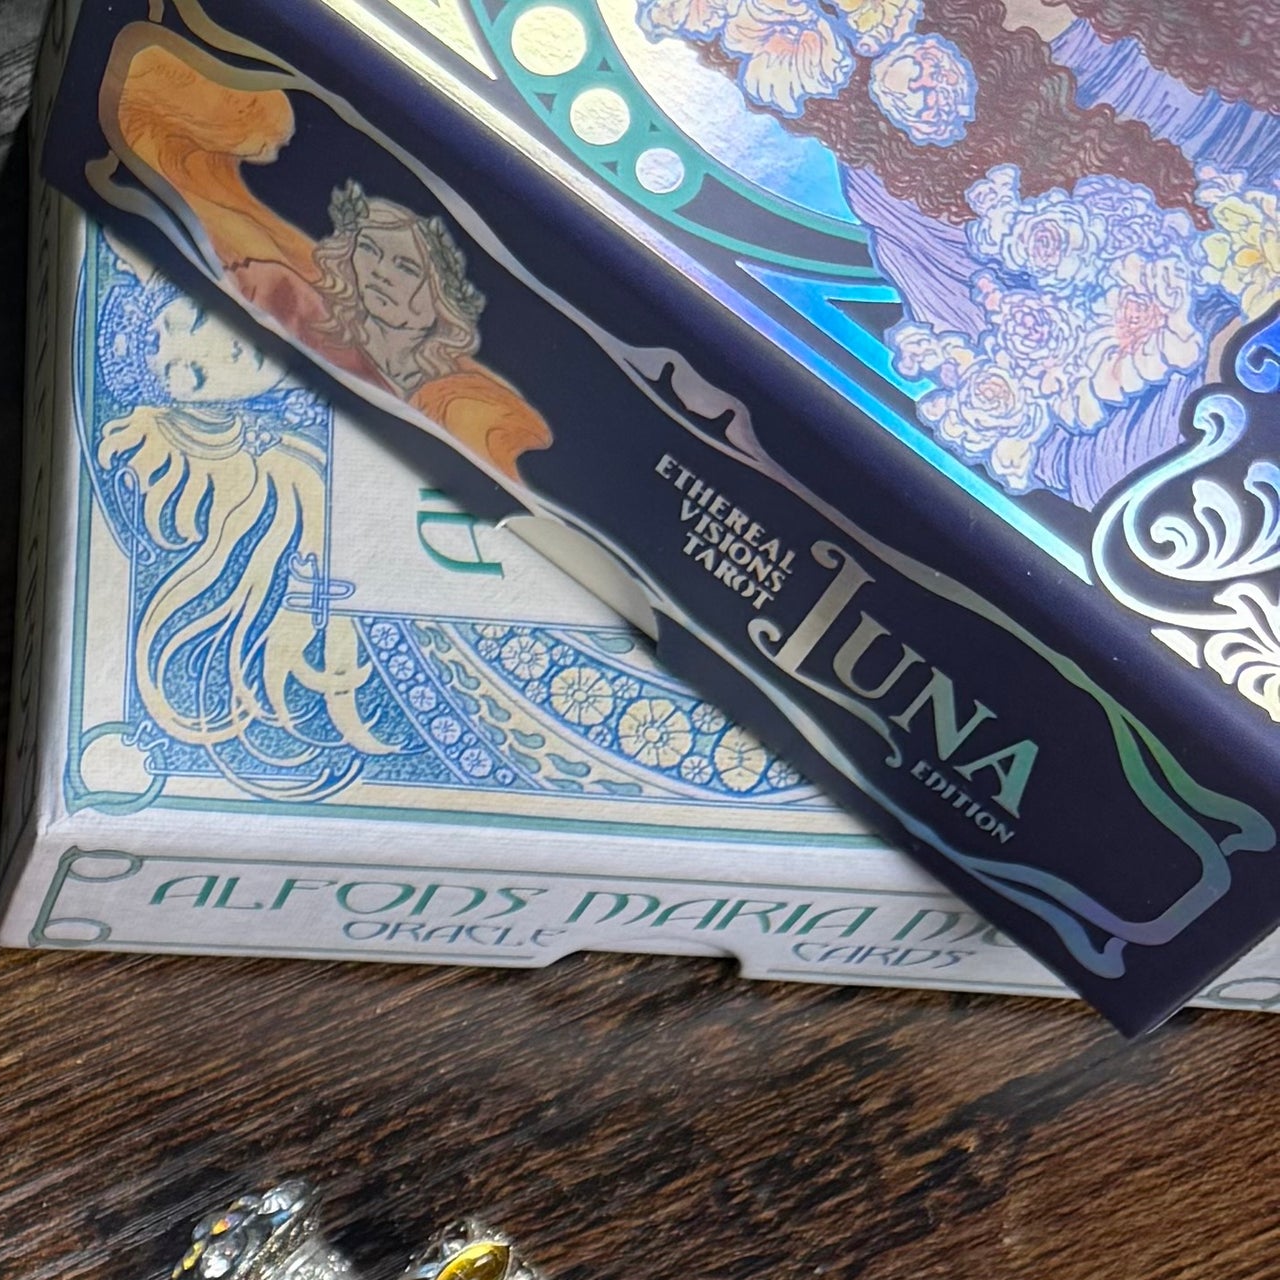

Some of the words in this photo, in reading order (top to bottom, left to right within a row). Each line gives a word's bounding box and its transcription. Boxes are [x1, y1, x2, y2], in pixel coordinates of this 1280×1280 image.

[654, 453, 797, 577] ETHEREAL
[678, 499, 793, 597] VISIONS
[682, 533, 776, 612] TAROT
[747, 539, 1040, 819] LUNA
[910, 760, 1015, 844] EDITION
[148, 873, 550, 918] ALFONS
[567, 888, 878, 938] MARIA
[341, 919, 567, 948] ORACLE
[791, 941, 977, 969] CARDS
